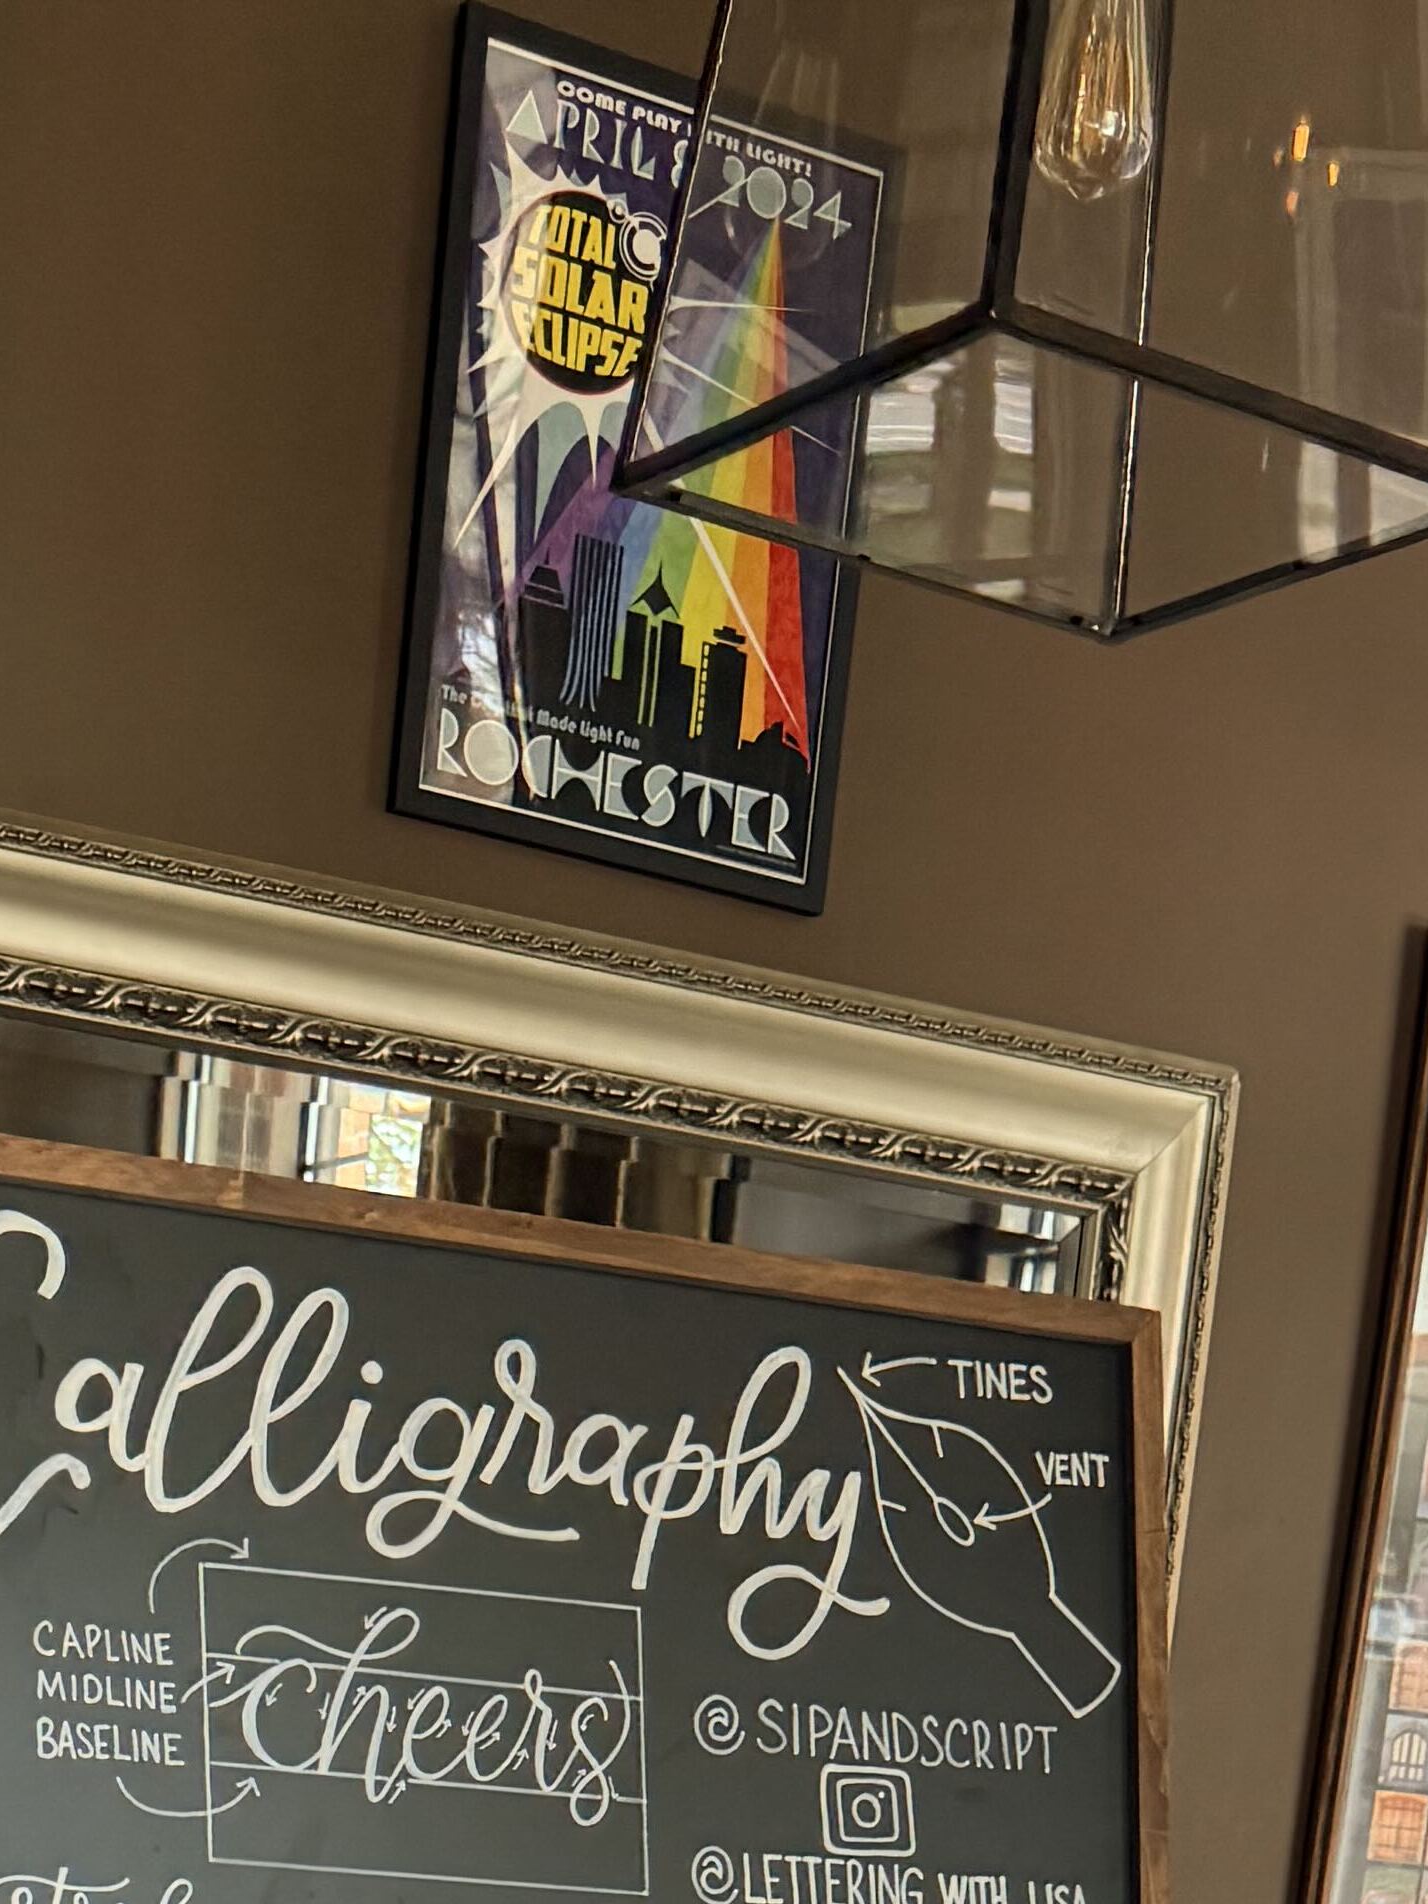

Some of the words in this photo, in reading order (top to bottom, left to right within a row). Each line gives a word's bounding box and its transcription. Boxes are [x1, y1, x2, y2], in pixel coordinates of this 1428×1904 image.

[556, 79, 627, 116] COME
[632, 104, 683, 134] PLAY
[745, 141, 812, 178] LIGHT!
[505, 89, 656, 181] APRIL
[688, 154, 852, 241] 2024
[529, 204, 619, 270] TOTAL
[511, 245, 650, 335] SOLAR
[518, 300, 644, 378] ECLIPSE
[536, 708, 577, 734] Made
[580, 719, 613, 744] Light
[436, 707, 796, 862] ROCHESTER
[947, 1357, 1053, 1404] TINES
[1034, 1450, 1110, 1489] VENT
[33, 1620, 175, 1667] CAPLINE
[36, 1669, 179, 1717] MIDLINE
[35, 1717, 185, 1769] BASELINE
